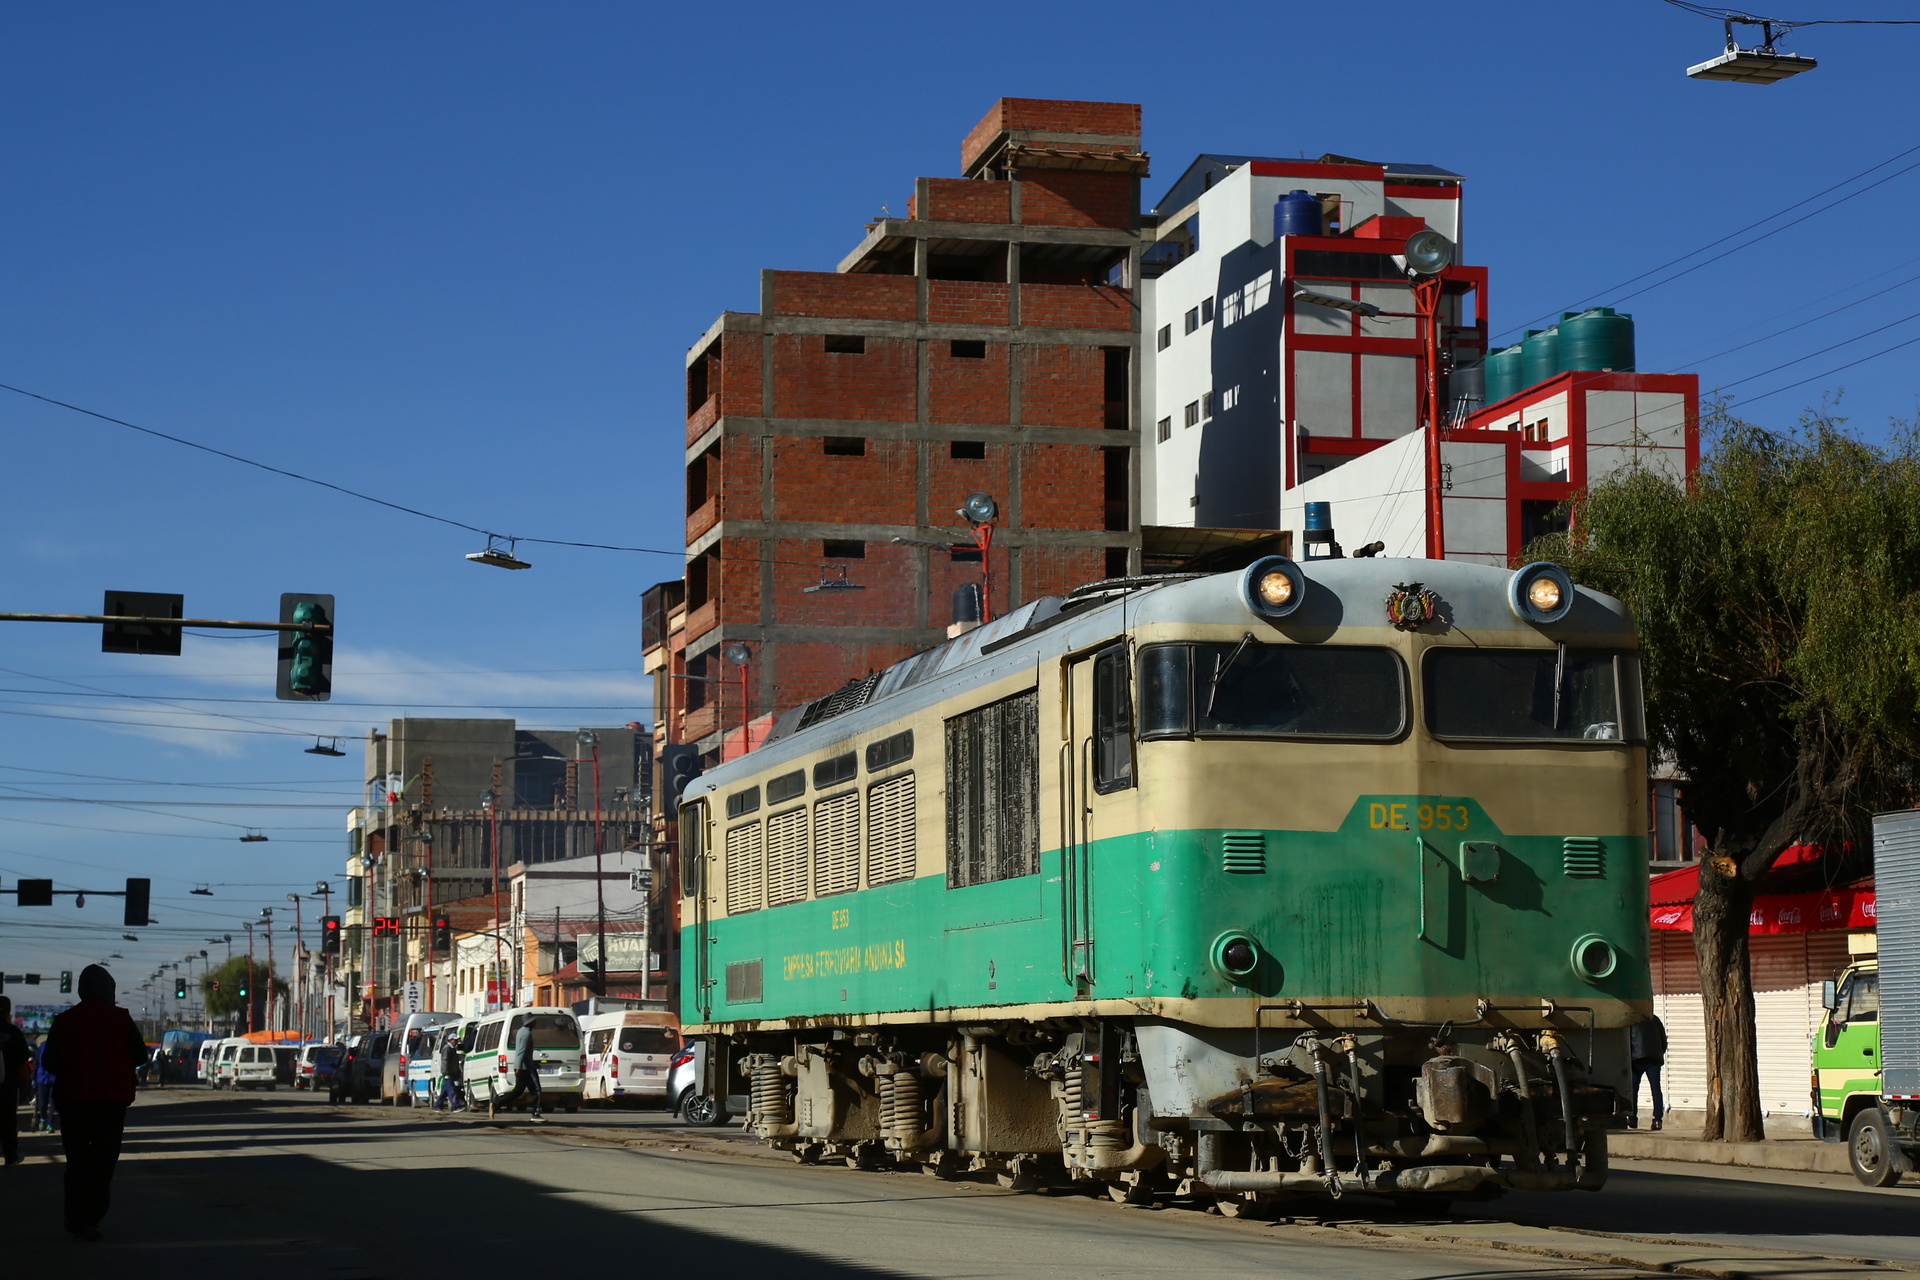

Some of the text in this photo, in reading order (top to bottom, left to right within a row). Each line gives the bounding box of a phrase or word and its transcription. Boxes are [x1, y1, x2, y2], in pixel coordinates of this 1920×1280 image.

[1369, 803, 1470, 831] DE 953
[374, 917, 400, 936] 24
